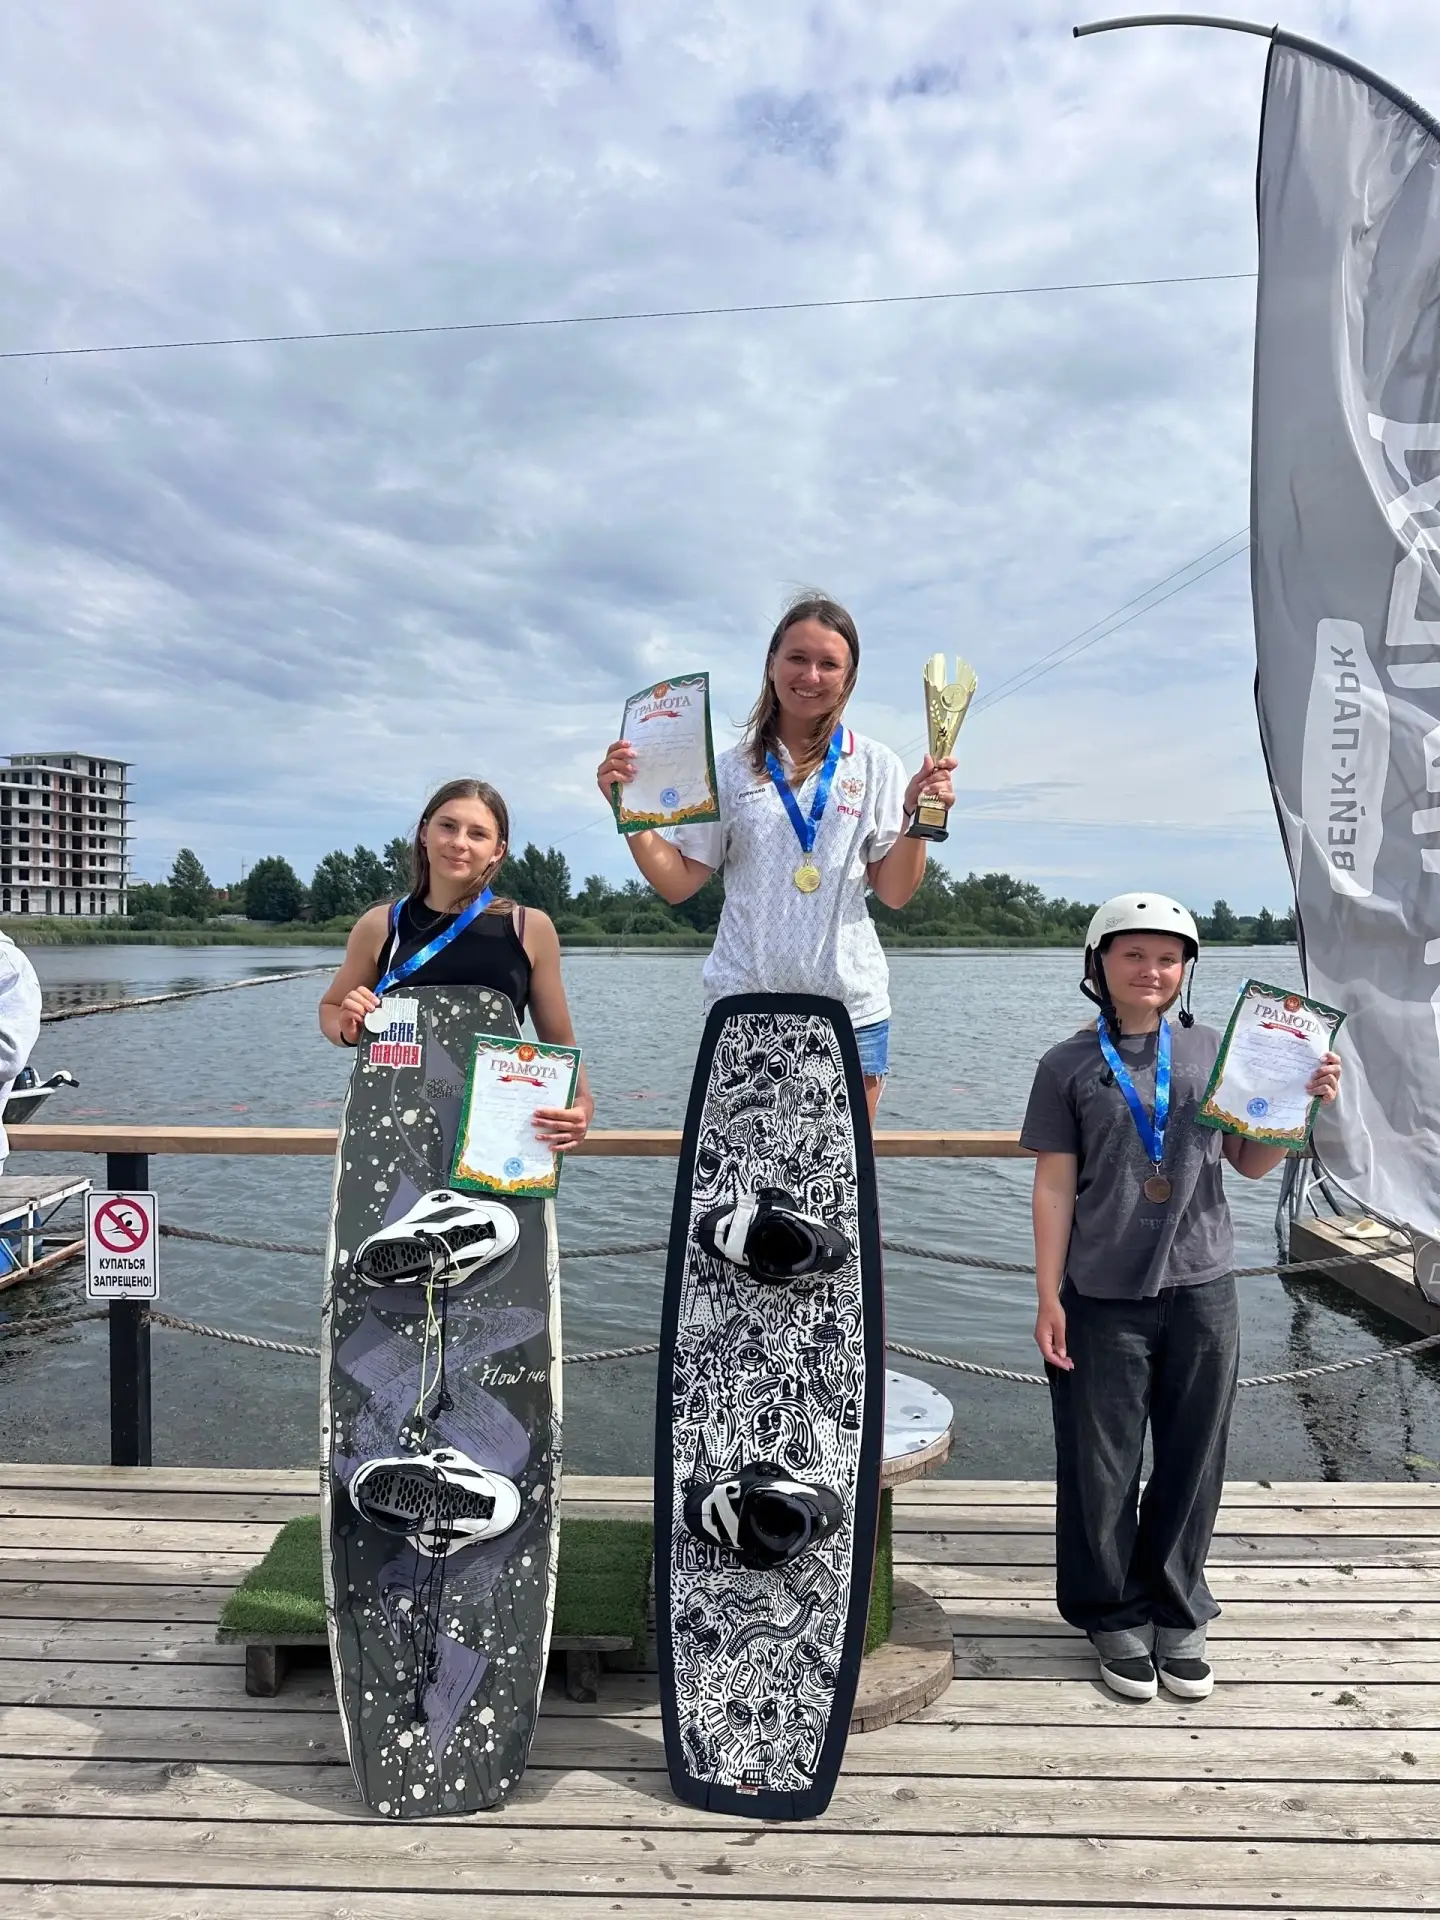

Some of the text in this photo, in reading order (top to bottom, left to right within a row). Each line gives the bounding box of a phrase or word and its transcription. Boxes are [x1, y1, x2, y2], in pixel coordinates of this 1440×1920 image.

[633, 695, 692, 719] ГРАМОТА
[836, 805, 862, 818] RUS
[1253, 1004, 1320, 1035] ГРАМОТА
[490, 1059, 558, 1079] ГРАМОТА
[99, 1258, 145, 1269] КУПАТЬСЯ
[93, 1275, 152, 1288] ЗАПРЕЩЕНО!
[479, 1364, 546, 1387] Flow 146
[704, 1654, 732, 1701] FORCE
